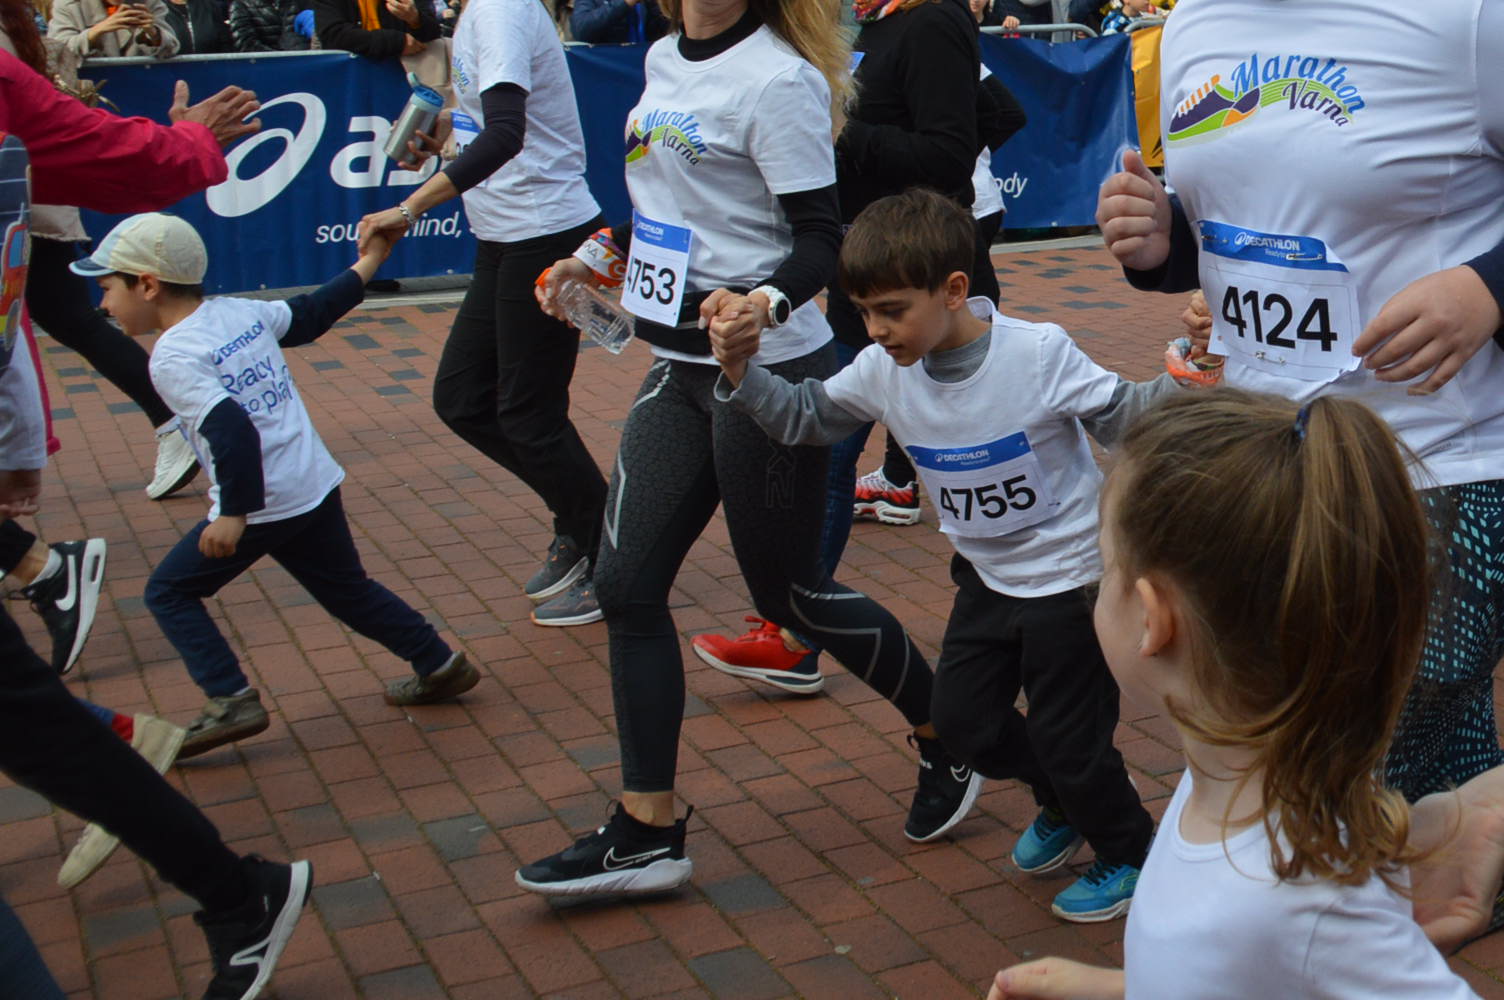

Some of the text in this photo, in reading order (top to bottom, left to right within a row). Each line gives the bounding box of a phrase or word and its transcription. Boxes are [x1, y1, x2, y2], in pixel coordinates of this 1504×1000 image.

[1231, 53, 1366, 114] Marathon
[1282, 80, 1349, 127] Varna
[642, 108, 708, 155] Marathon
[993, 172, 1028, 198] ody
[315, 223, 361, 244] sou
[1245, 236, 1300, 251] DECATHLON
[1221, 285, 1338, 352] 4124
[940, 474, 1037, 521] 4755
